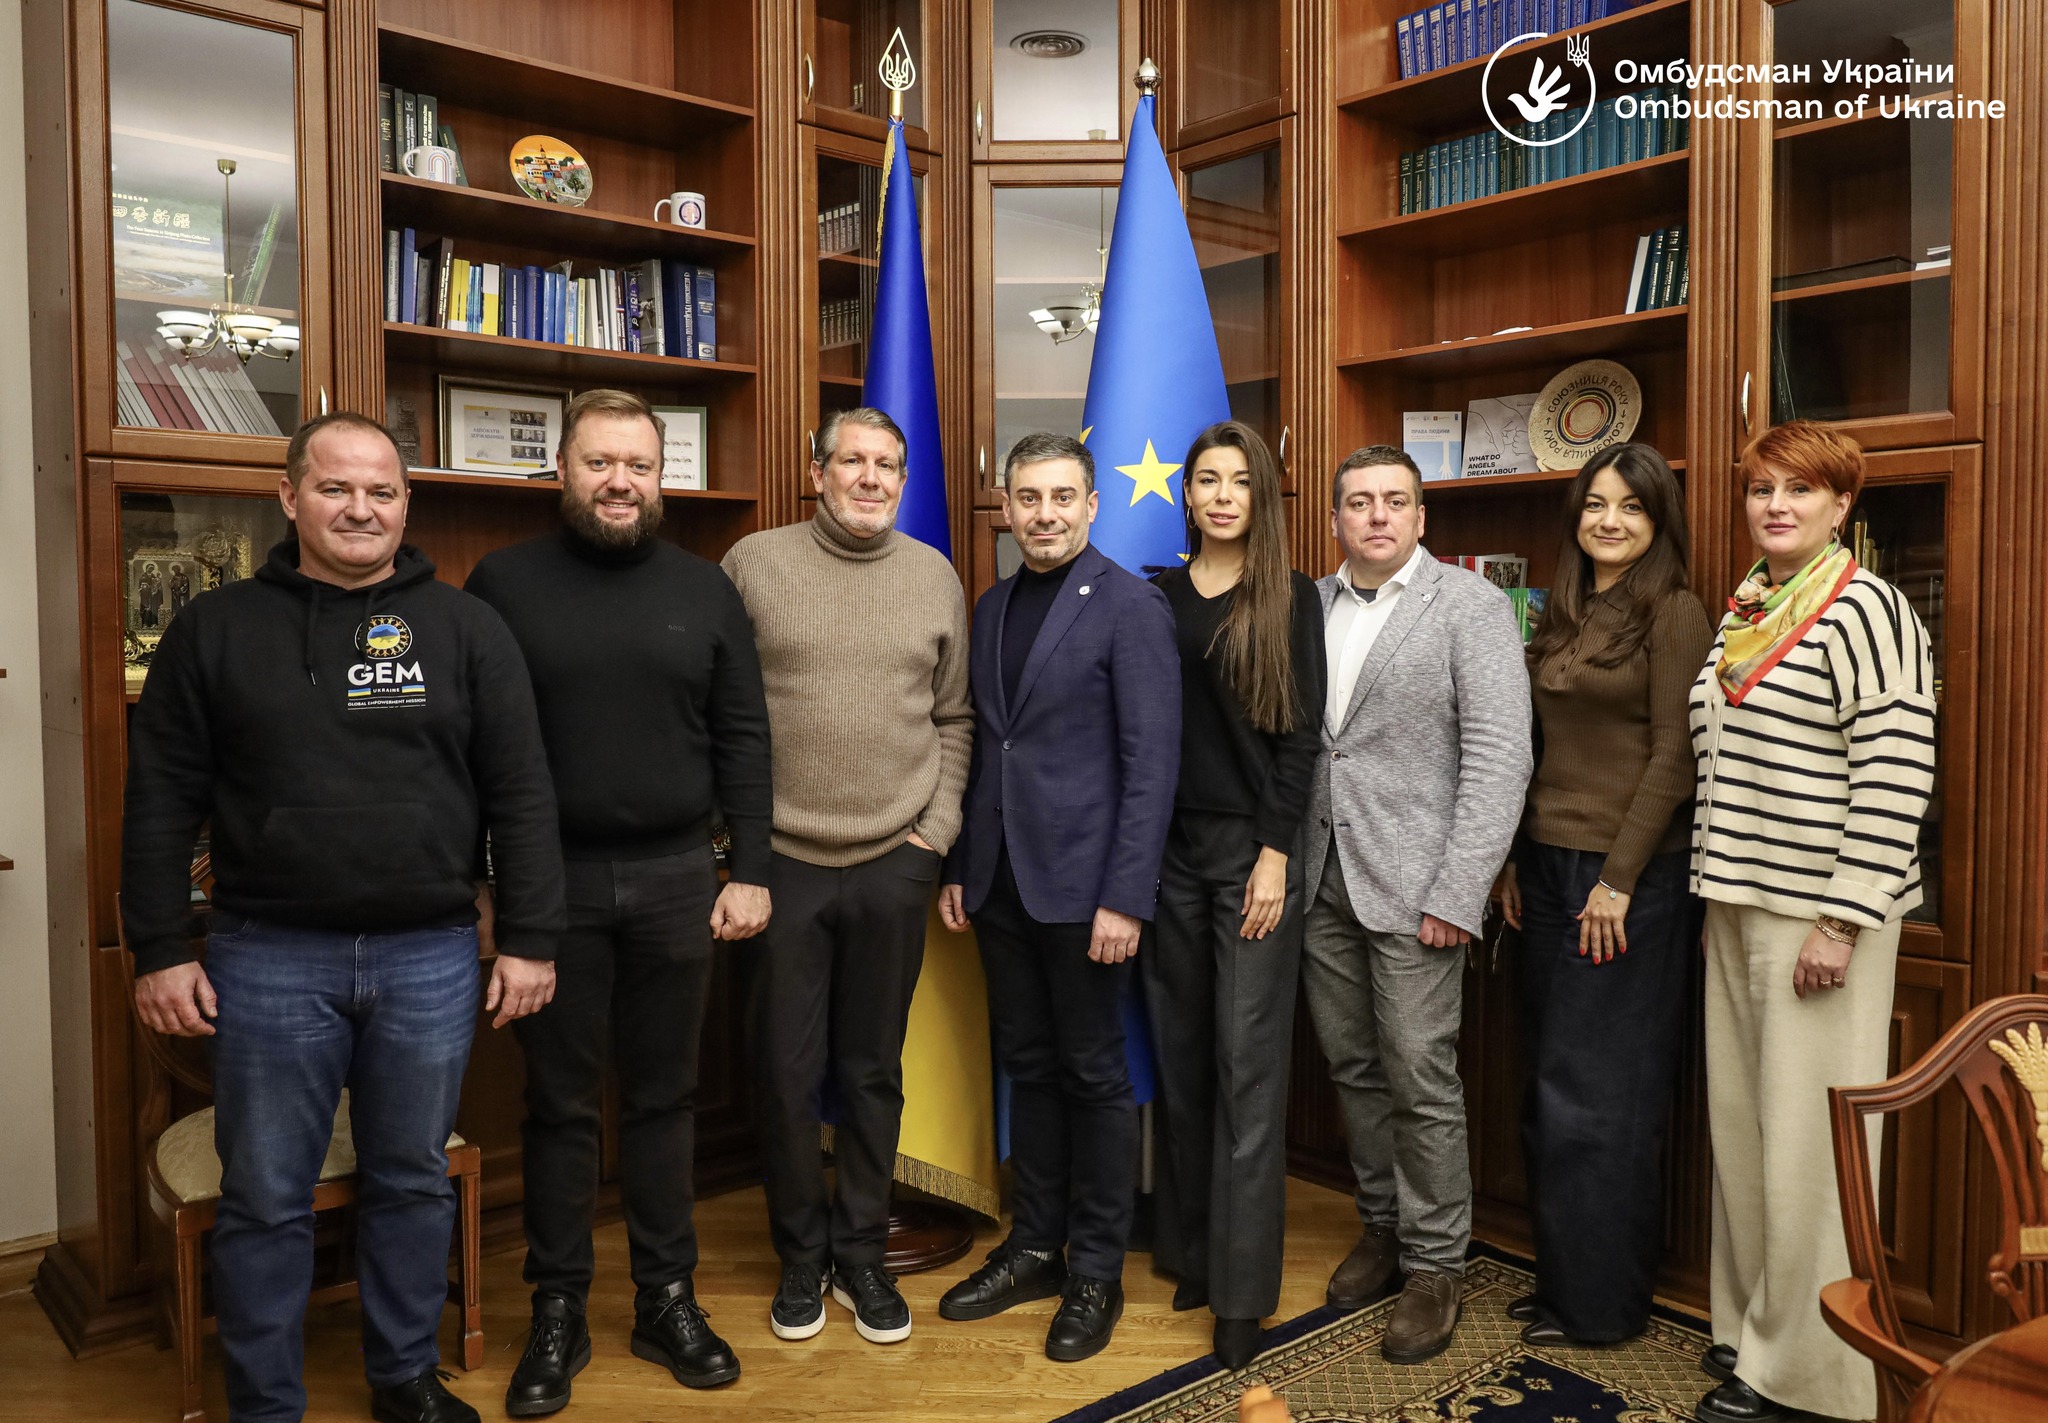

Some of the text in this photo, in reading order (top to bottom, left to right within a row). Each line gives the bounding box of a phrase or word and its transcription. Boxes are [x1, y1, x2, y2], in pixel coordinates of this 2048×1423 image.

[1548, 375, 1629, 413] СОЮЗНИЦЯ РОКУ
[1543, 429, 1563, 454] РОКУ
[1467, 467, 1518, 477] DREAM ABOUT
[347, 660, 424, 686] GEM
